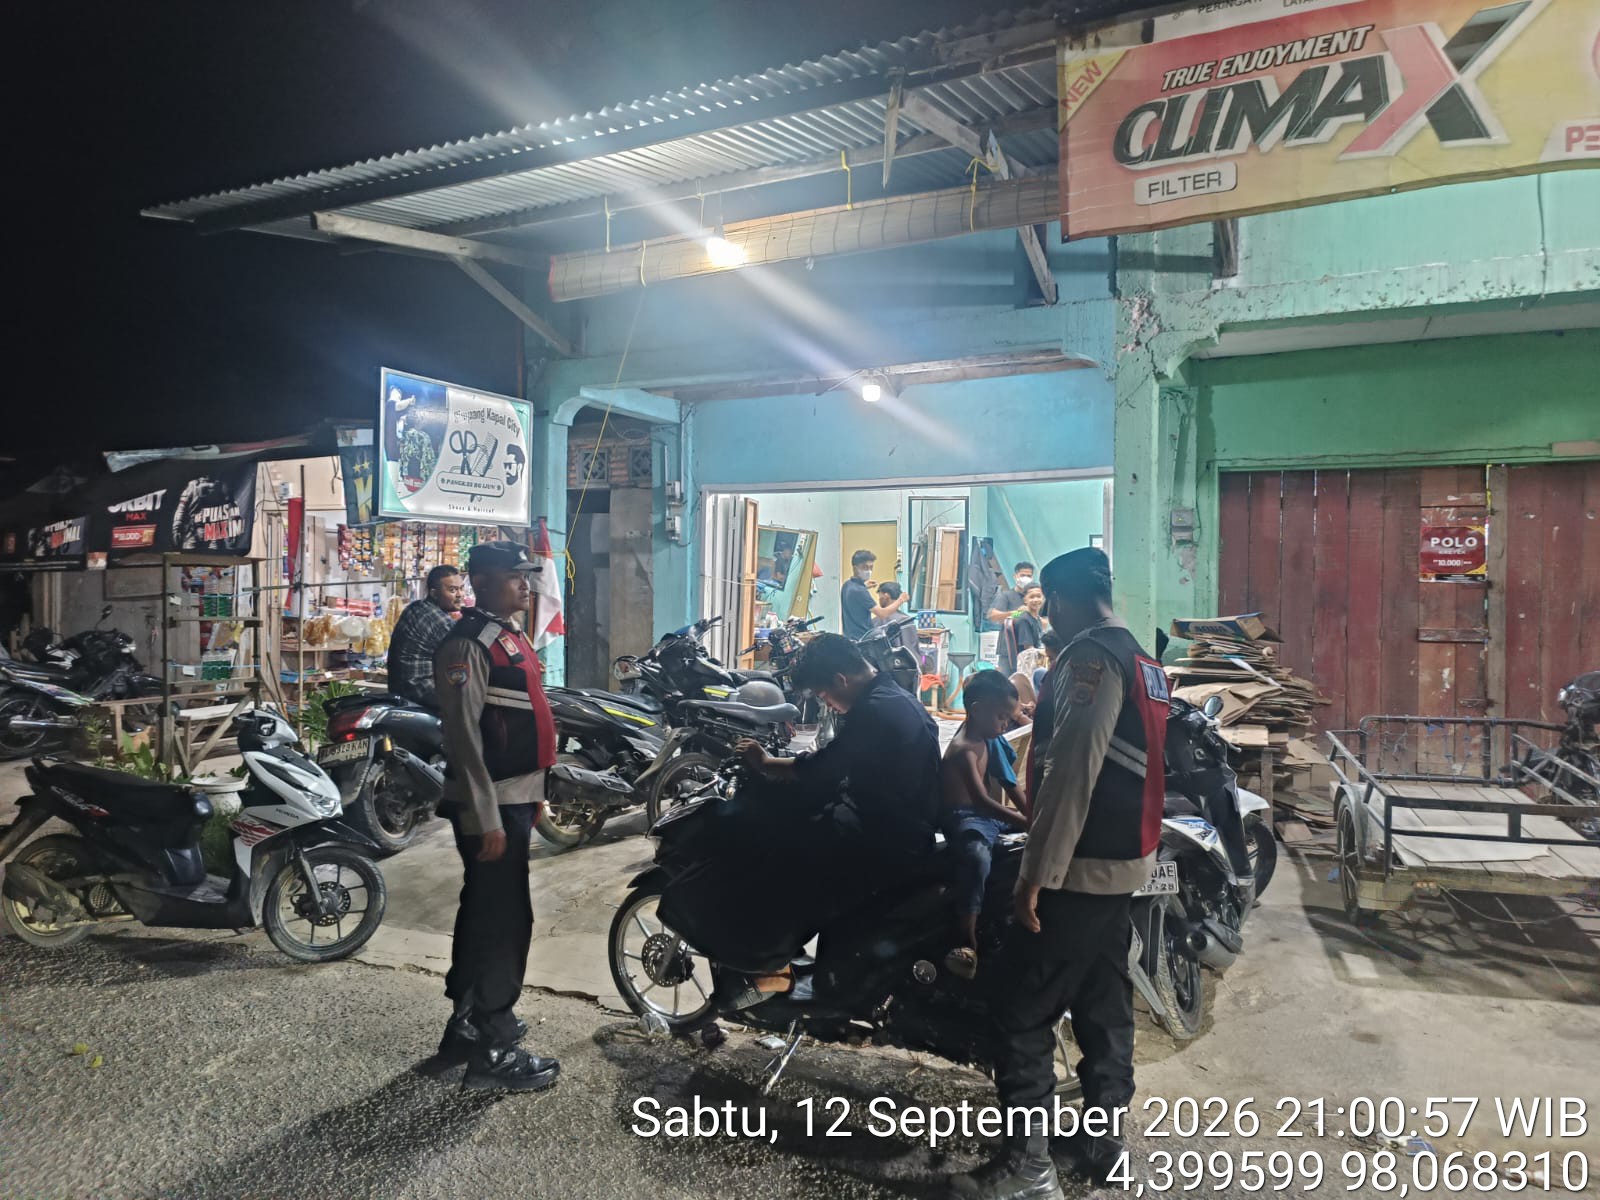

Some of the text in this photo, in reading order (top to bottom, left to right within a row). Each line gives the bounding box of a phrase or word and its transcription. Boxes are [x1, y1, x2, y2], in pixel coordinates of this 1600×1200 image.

[1161, 25, 1374, 92] TRUE ENJOYMENT
[1061, 61, 1102, 110] NEW
[1112, 0, 1550, 168] CLIMAX
[1148, 171, 1222, 198] FILTER
[507, 417, 520, 438] City
[1430, 537, 1478, 548] POLO
